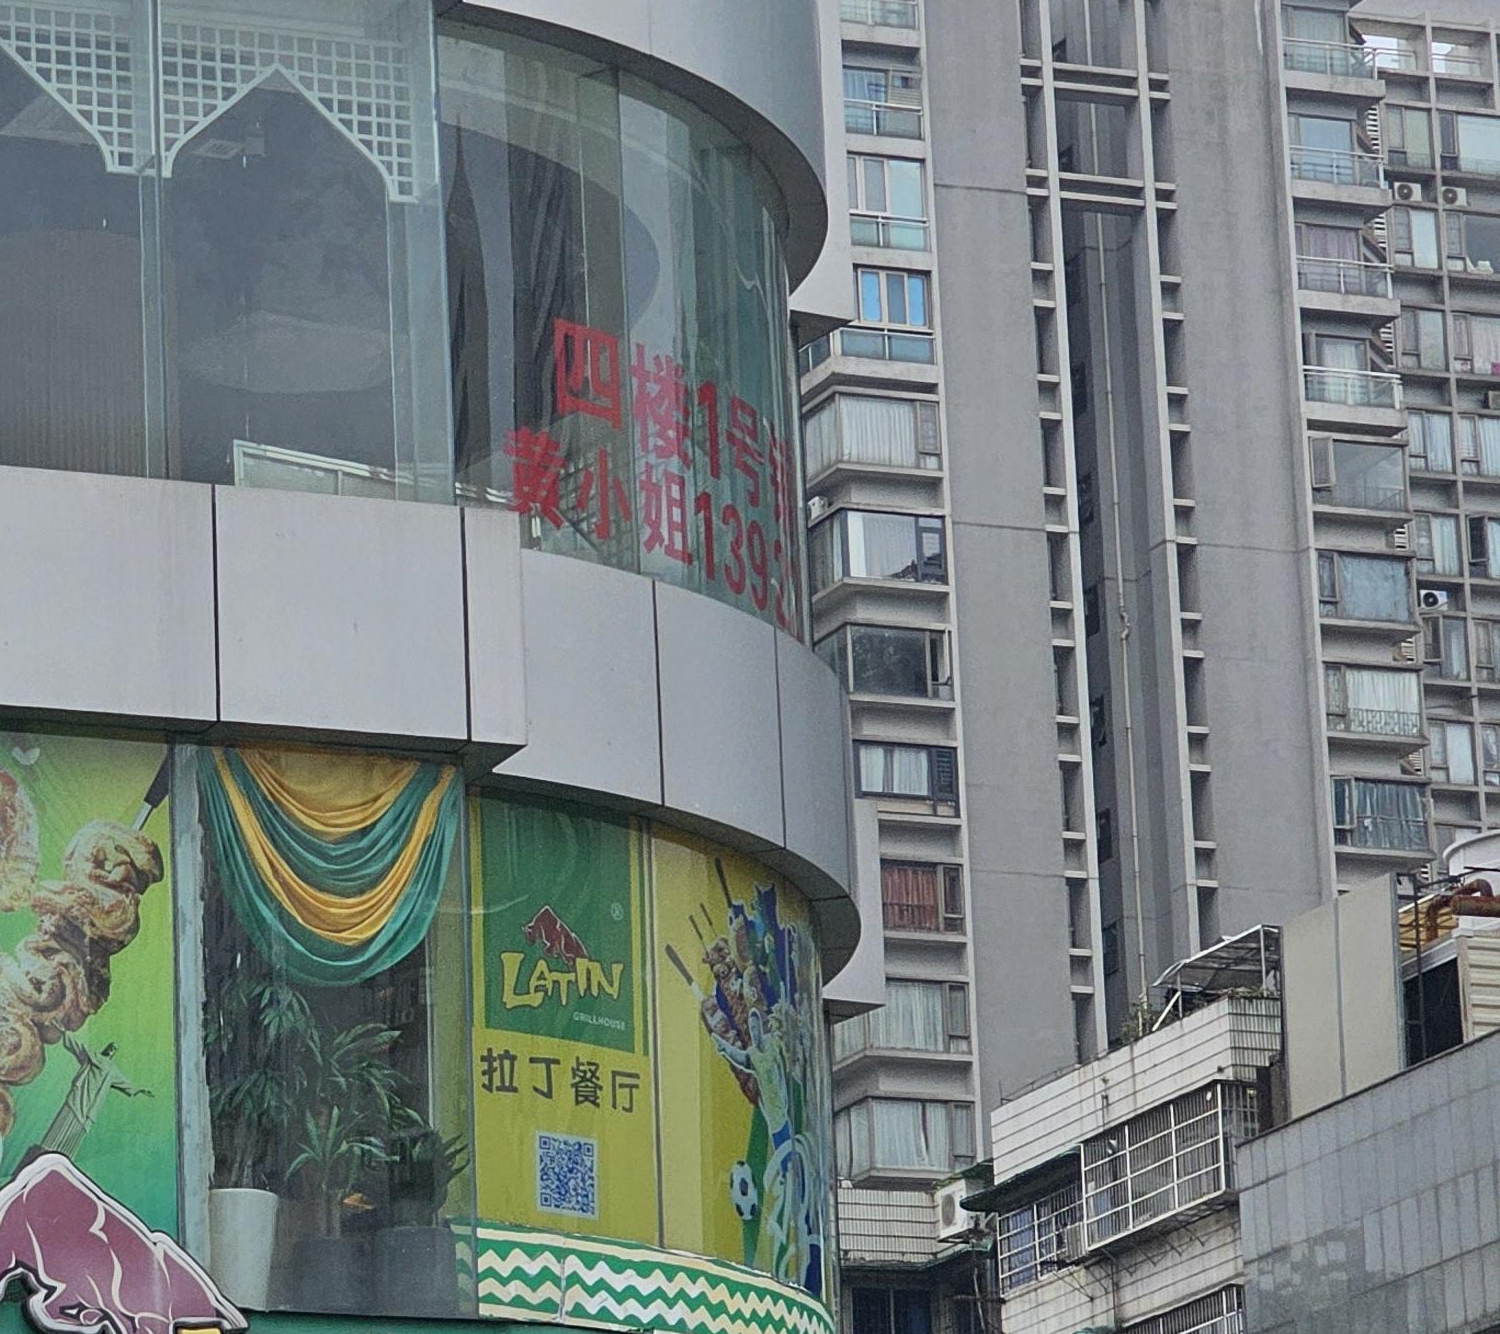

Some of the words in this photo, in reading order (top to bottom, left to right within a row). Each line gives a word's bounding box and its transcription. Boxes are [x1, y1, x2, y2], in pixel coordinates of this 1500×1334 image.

[500, 950, 624, 1011] LATIN
[573, 1010, 626, 1032] GRILLHOUSE
[479, 1047, 641, 1114] 拉丁餐厅
